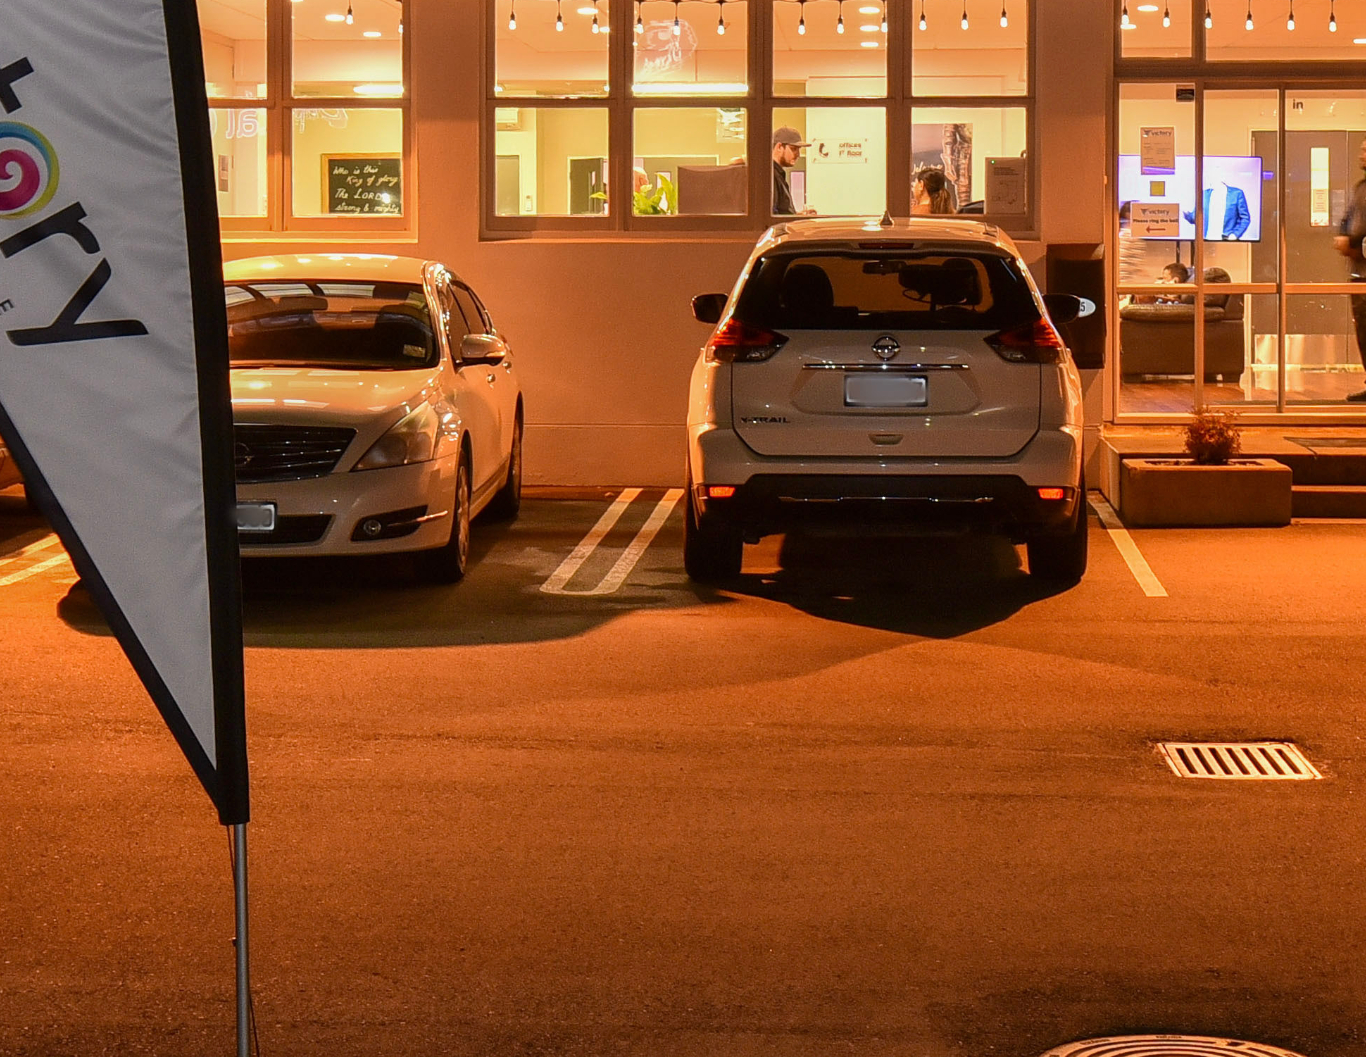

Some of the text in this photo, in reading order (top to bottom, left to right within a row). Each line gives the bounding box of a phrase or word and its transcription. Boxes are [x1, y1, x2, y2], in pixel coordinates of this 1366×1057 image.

[1292, 99, 1304, 110] in
[346, 174, 399, 187] King of glory
[335, 187, 349, 199] The
